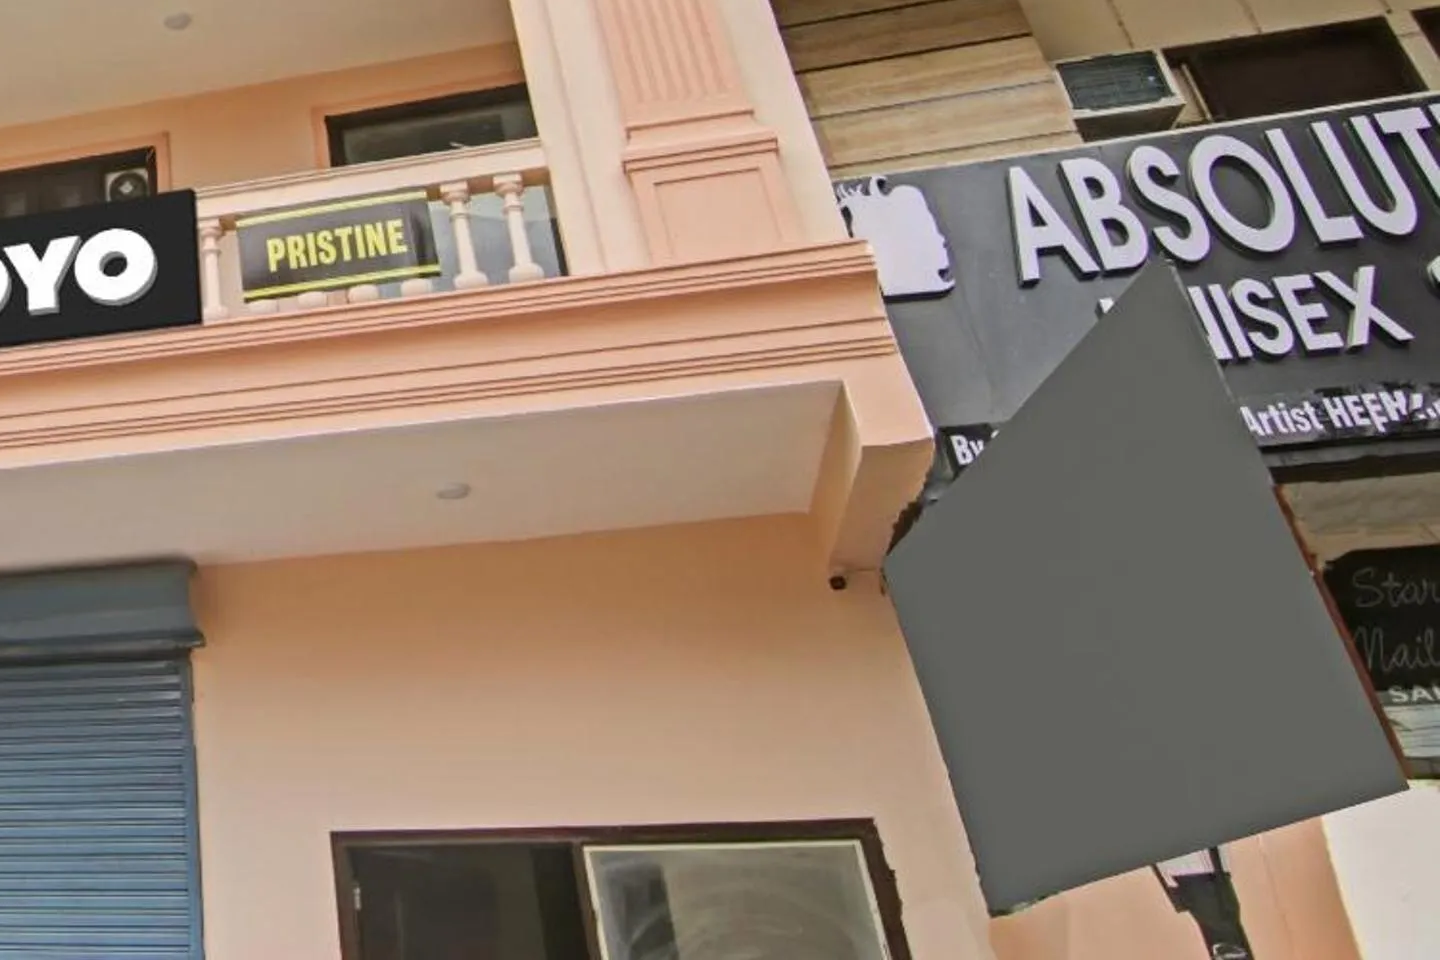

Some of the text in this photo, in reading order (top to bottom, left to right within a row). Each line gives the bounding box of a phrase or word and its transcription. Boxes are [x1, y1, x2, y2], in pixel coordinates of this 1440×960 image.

[1007, 103, 1440, 285] ABSOLUT
[266, 219, 408, 273] PRISTINE
[1239, 400, 1324, 437] Artist
